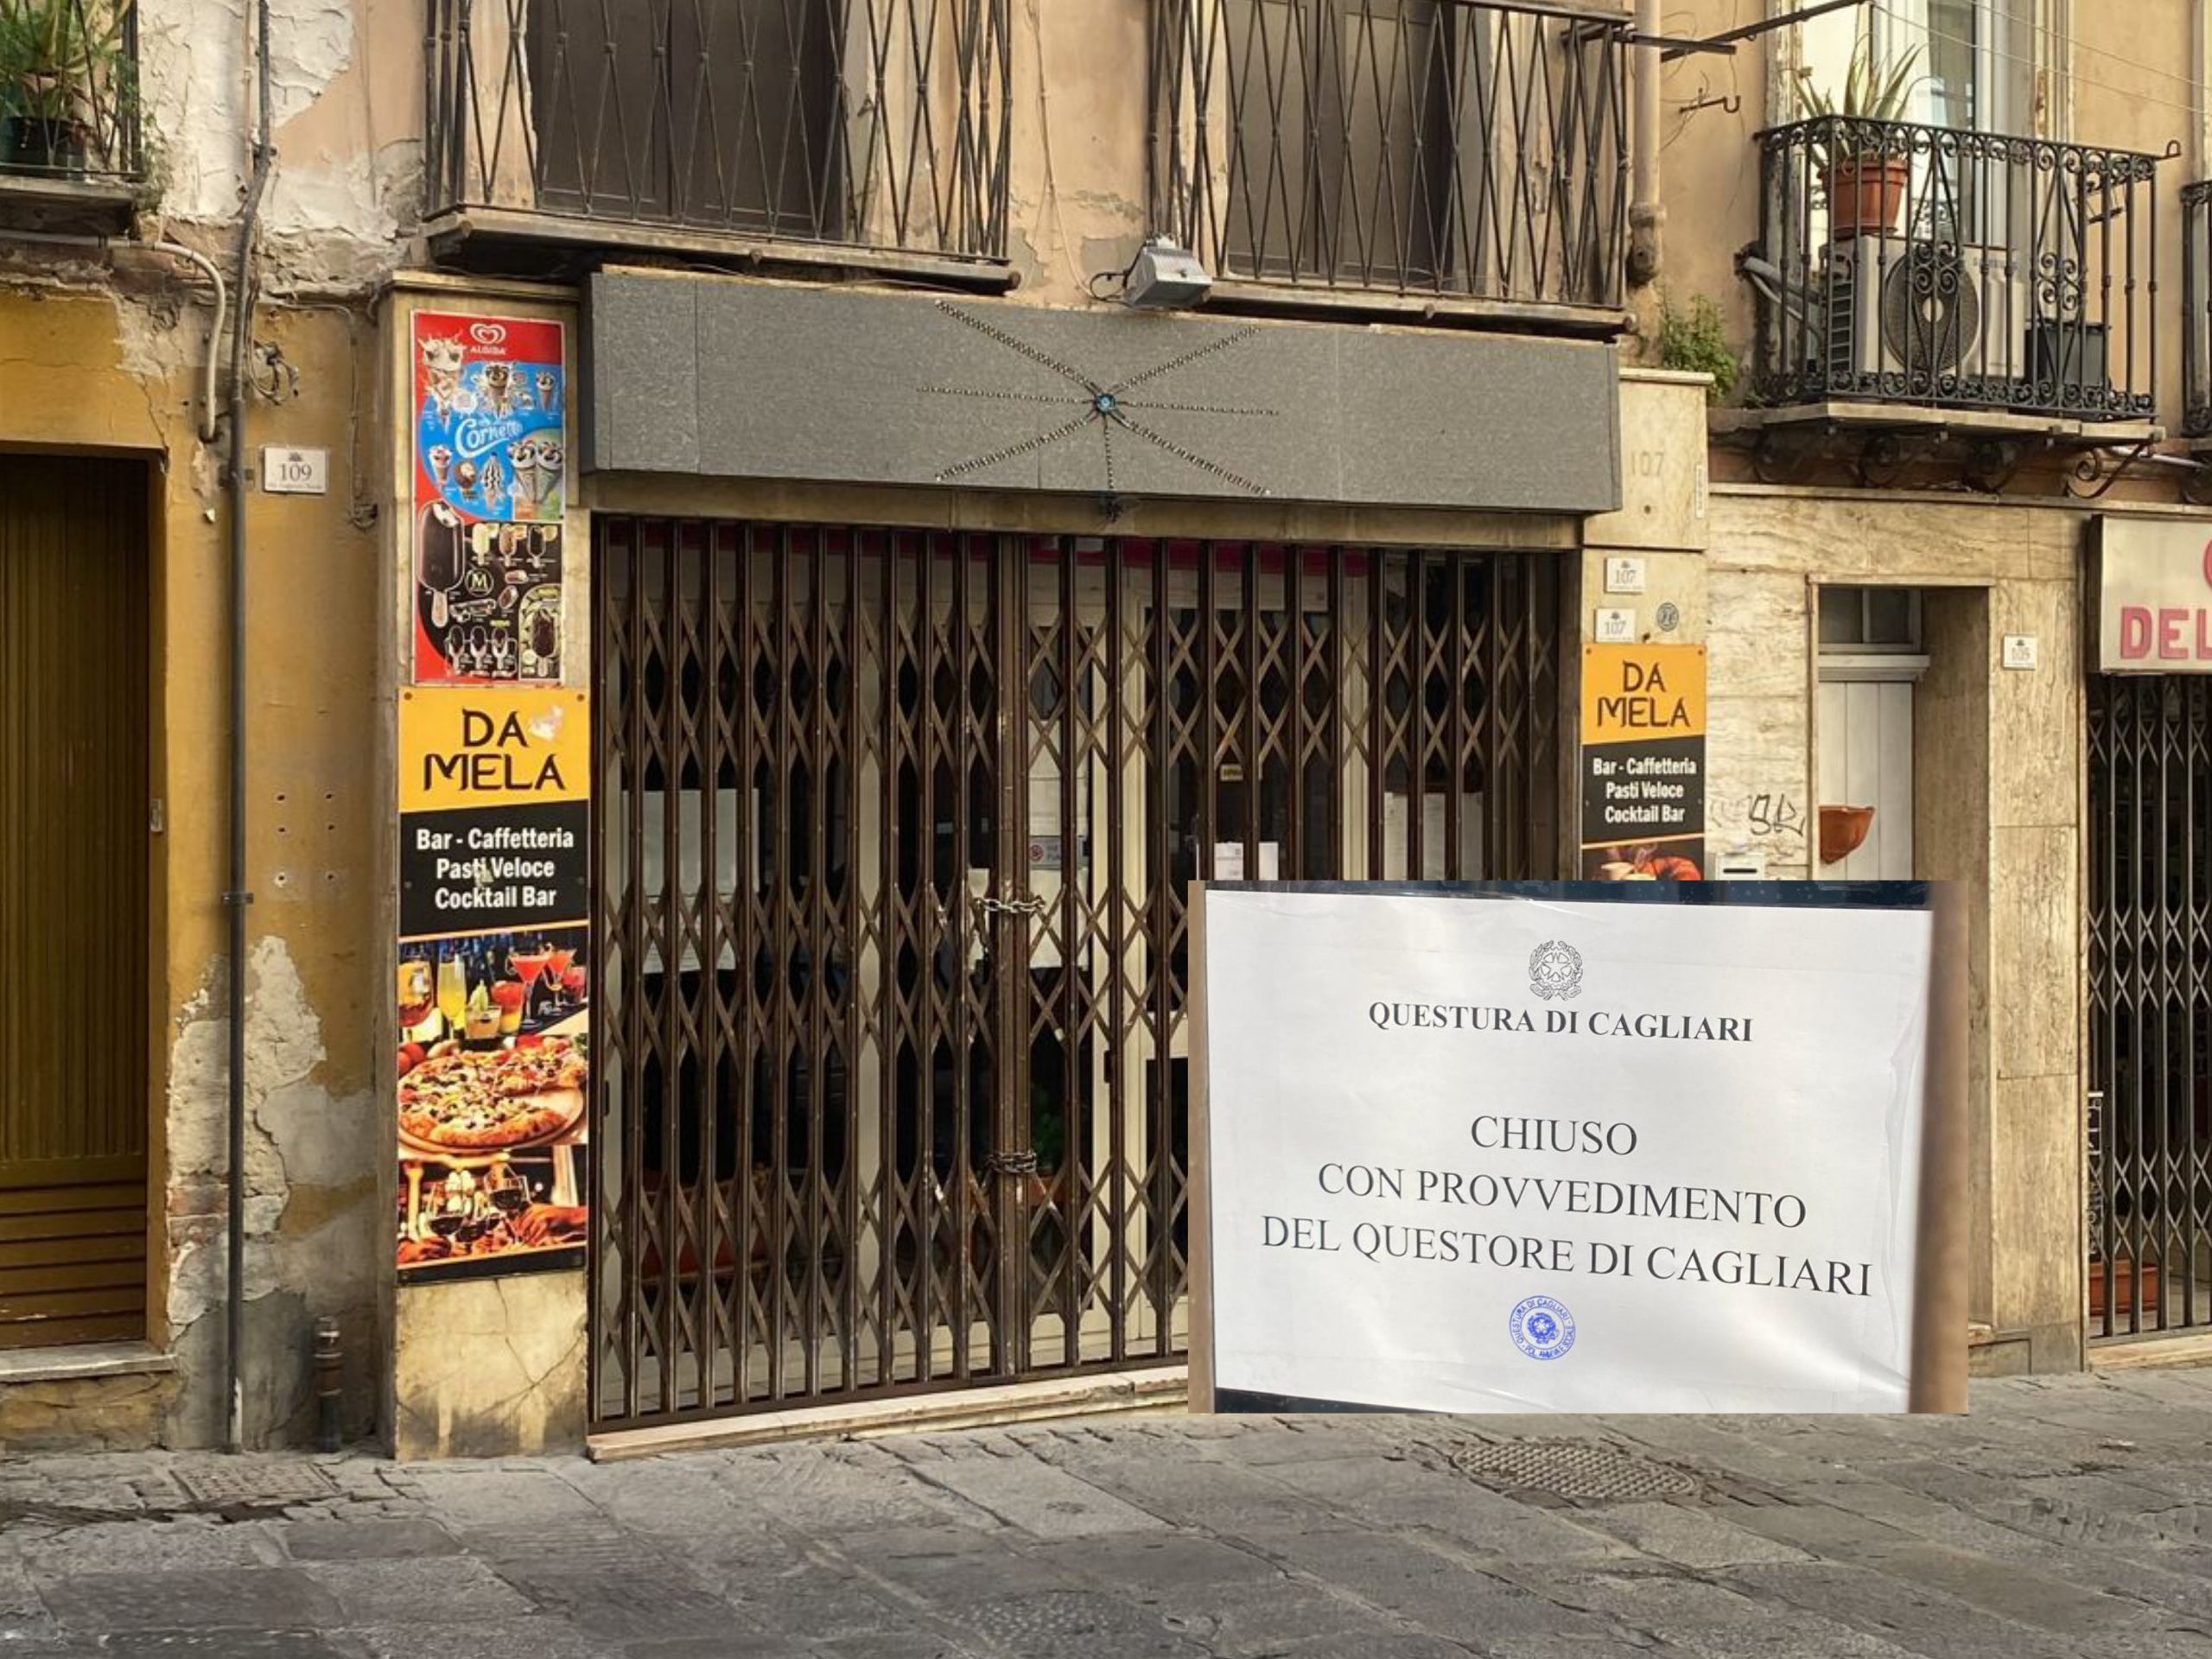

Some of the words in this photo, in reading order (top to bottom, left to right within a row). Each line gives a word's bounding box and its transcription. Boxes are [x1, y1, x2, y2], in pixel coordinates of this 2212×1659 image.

[279, 462, 312, 482] 109
[1630, 451, 1664, 476] 107
[1616, 569, 1637, 584] 107
[1605, 620, 1627, 635] 107
[1623, 660, 1666, 692] DA
[1598, 696, 1691, 728] MELA
[462, 708, 530, 747] DA
[423, 753, 566, 791] MELA
[1593, 758, 1617, 775] Bar
[1626, 757, 1697, 775] Caffetteria
[1605, 781, 1639, 799] Pasti
[1641, 780, 1683, 798] Veloce
[1605, 804, 1659, 823] Cocktail
[1662, 804, 1686, 823] Bar
[416, 828, 453, 850] Bar
[467, 827, 574, 849] Caffetteria
[436, 857, 486, 880] Pasti
[490, 856, 555, 879] Veloce
[435, 886, 518, 909] Cocktail
[522, 886, 556, 907] Bar
[1369, 1001, 1536, 1033] QUESTURA
[1546, 1009, 1579, 1034] DI
[1588, 1011, 1753, 1042] CAGLIARI
[1471, 1115, 1637, 1156] CHIUSO
[1318, 1162, 1404, 1200] CON
[1417, 1170, 1807, 1229] PROVVEDIMENTO
[1262, 1215, 1341, 1252] DEL
[1352, 1222, 1574, 1273] QUESTORE
[1587, 1242, 1634, 1278] DI
[1647, 1245, 1873, 1297] CAGLIARI
[1527, 1300, 1535, 1308] DI
[1536, 1299, 1569, 1321] CAGLIARI
